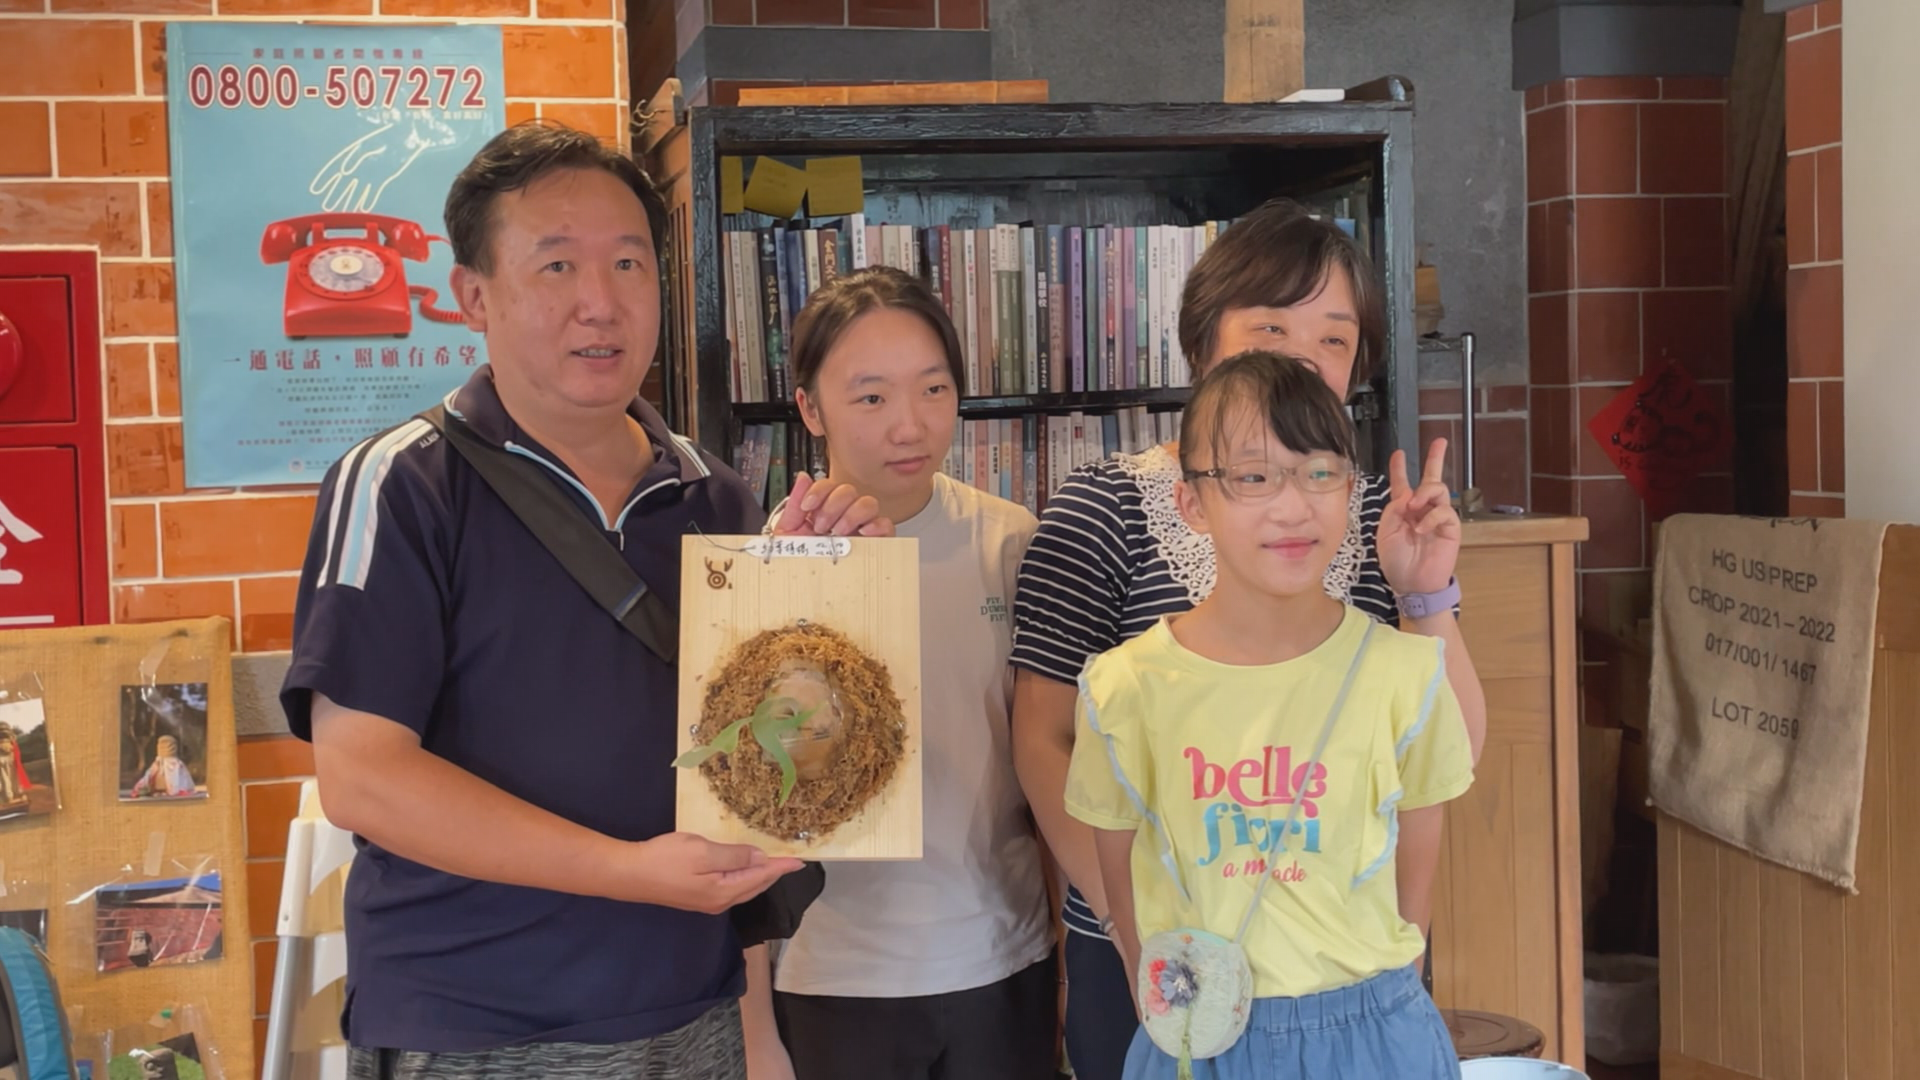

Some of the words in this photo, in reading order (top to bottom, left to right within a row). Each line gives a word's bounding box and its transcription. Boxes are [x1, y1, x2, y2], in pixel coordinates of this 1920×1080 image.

[188, 63, 487, 110] 0800-507272
[1712, 548, 1737, 573] HG
[1742, 559, 1766, 582] US
[1769, 566, 1818, 593] PREP
[1688, 586, 1735, 615] CROP
[1712, 697, 1753, 725] LOT
[1183, 745, 1328, 819] belle
[1198, 802, 1322, 866] fiori
[1223, 862, 1239, 878] a
[1244, 858, 1307, 882] macle
